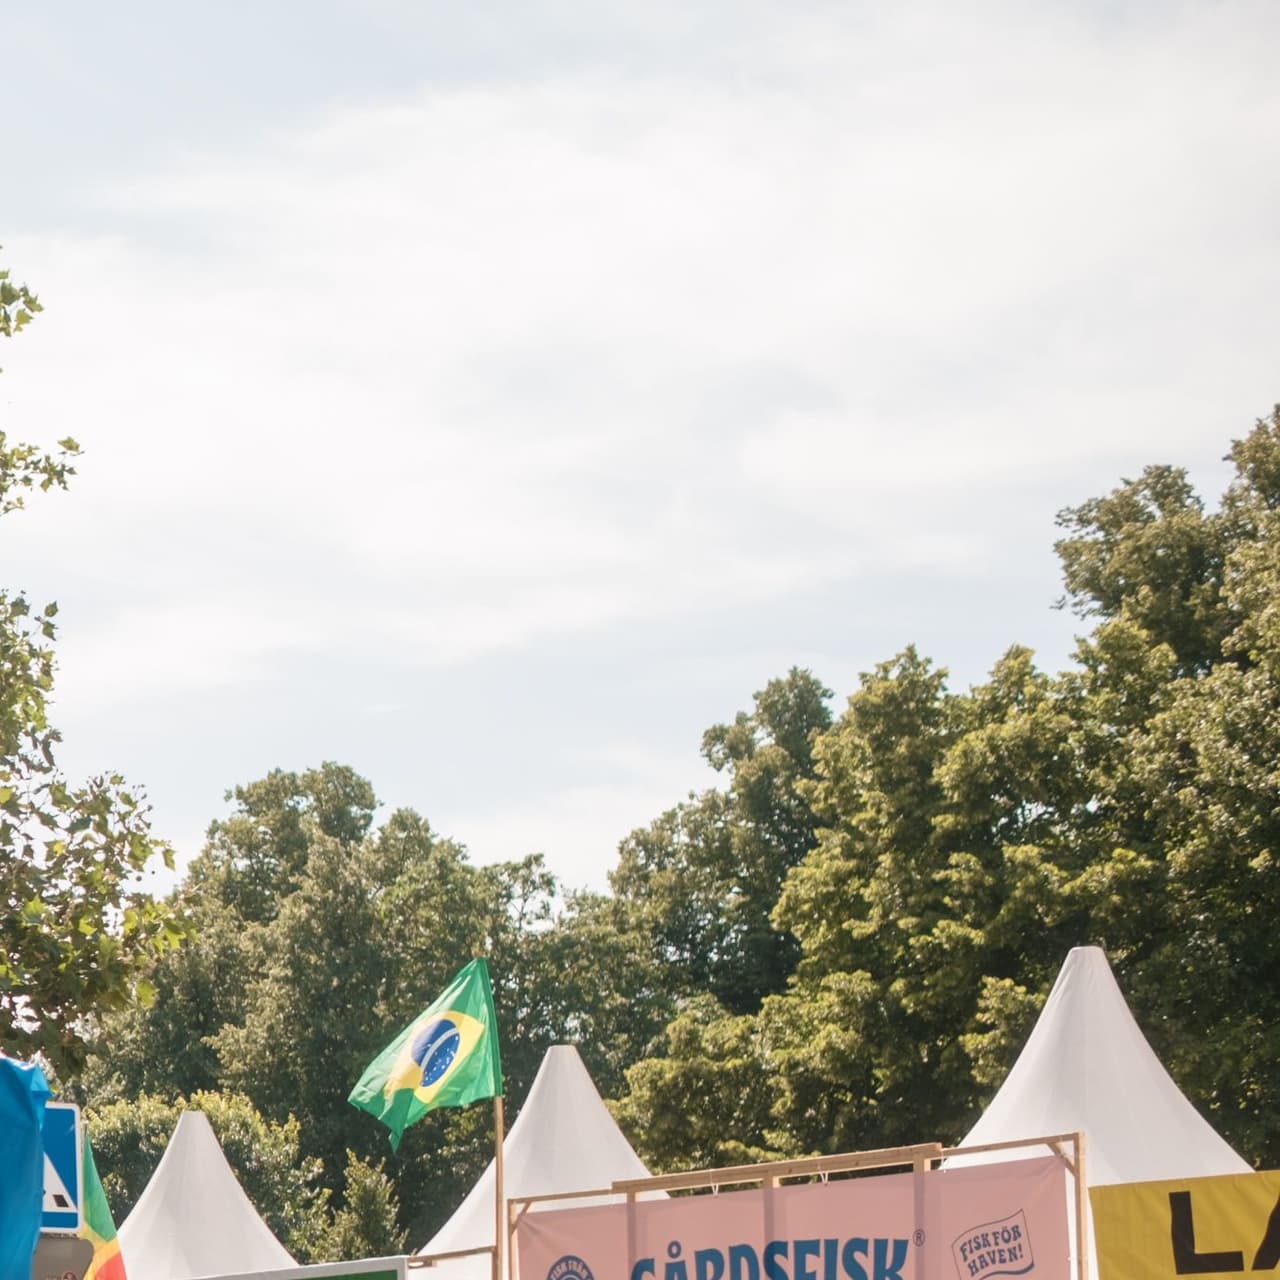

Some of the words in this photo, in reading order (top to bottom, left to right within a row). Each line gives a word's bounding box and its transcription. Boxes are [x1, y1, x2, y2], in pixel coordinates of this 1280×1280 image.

[960, 1232, 991, 1262] FISK
[992, 1224, 1022, 1247] FÖR
[967, 1243, 1023, 1277] HAVEN!
